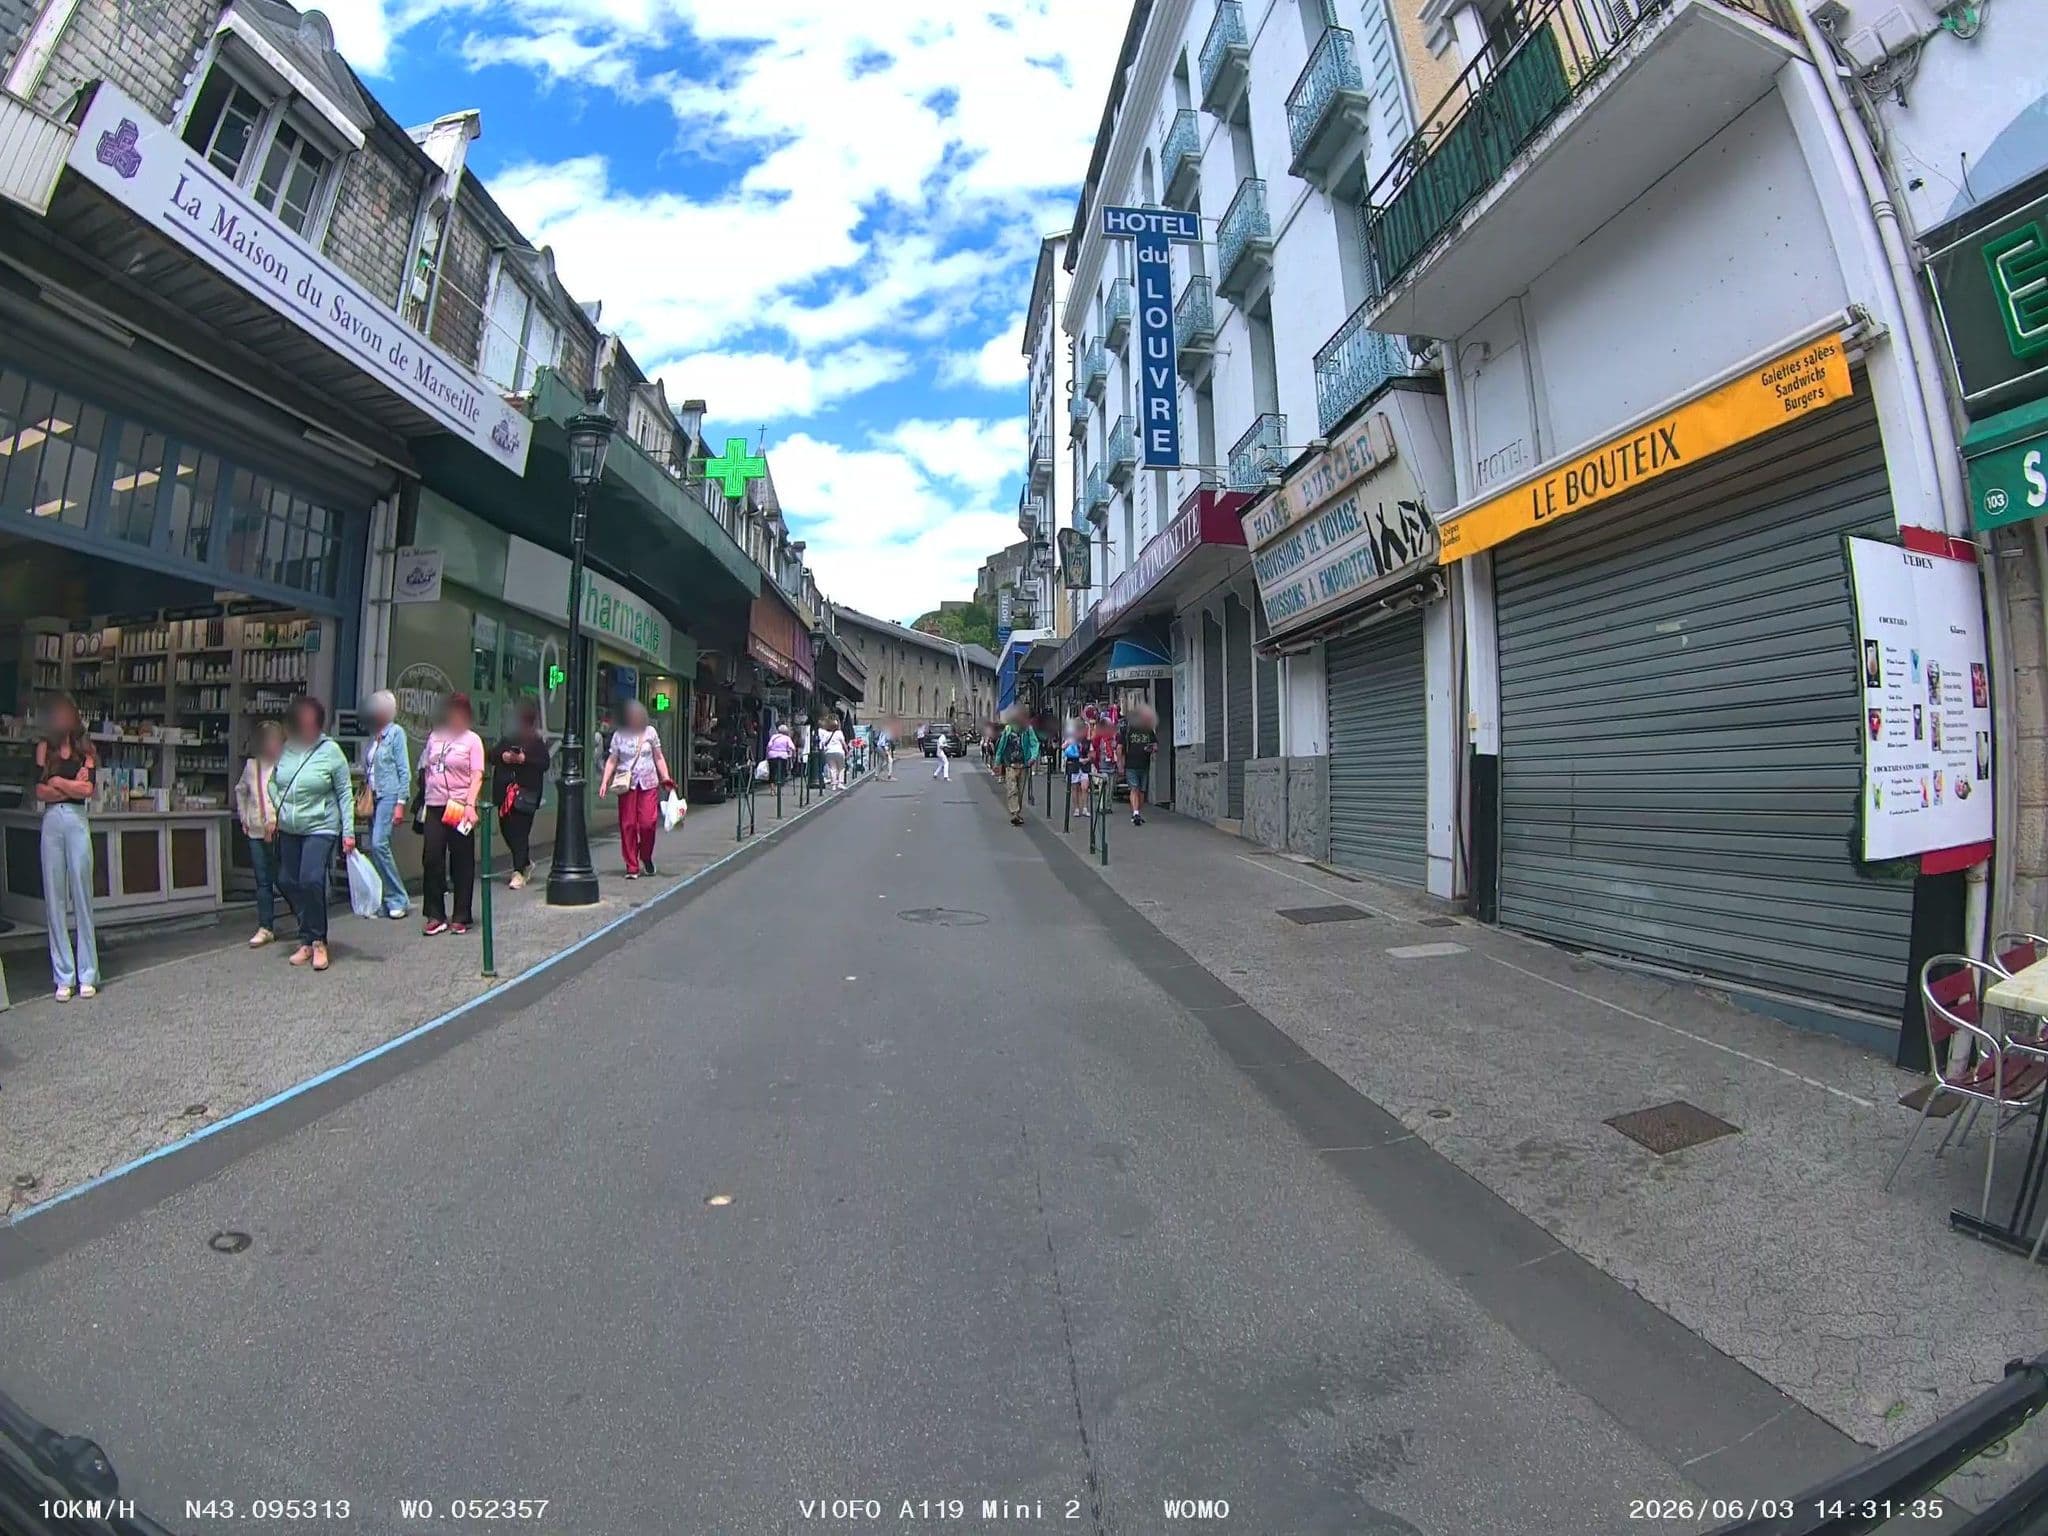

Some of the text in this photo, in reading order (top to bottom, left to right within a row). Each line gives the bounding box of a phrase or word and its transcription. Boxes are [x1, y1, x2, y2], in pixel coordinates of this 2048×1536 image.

[1107, 211, 1195, 236] HOTEL
[1138, 246, 1169, 264] du
[170, 173, 481, 423] La Maison du Savon de Marseille
[1146, 278, 1172, 453] LOUVRE
[1761, 360, 1801, 386] Galettes
[1775, 367, 1826, 399] Sandwichs
[1784, 387, 1825, 412] Burgers
[1532, 422, 1681, 521] LE BOUTEIX
[1986, 495, 2005, 508] 103
[1254, 497, 1362, 584] PROVISIONS DE VOYAGE
[1264, 546, 1377, 624] BOISSONS A EMPORTER
[1001, 594, 1009, 622] HOTEL
